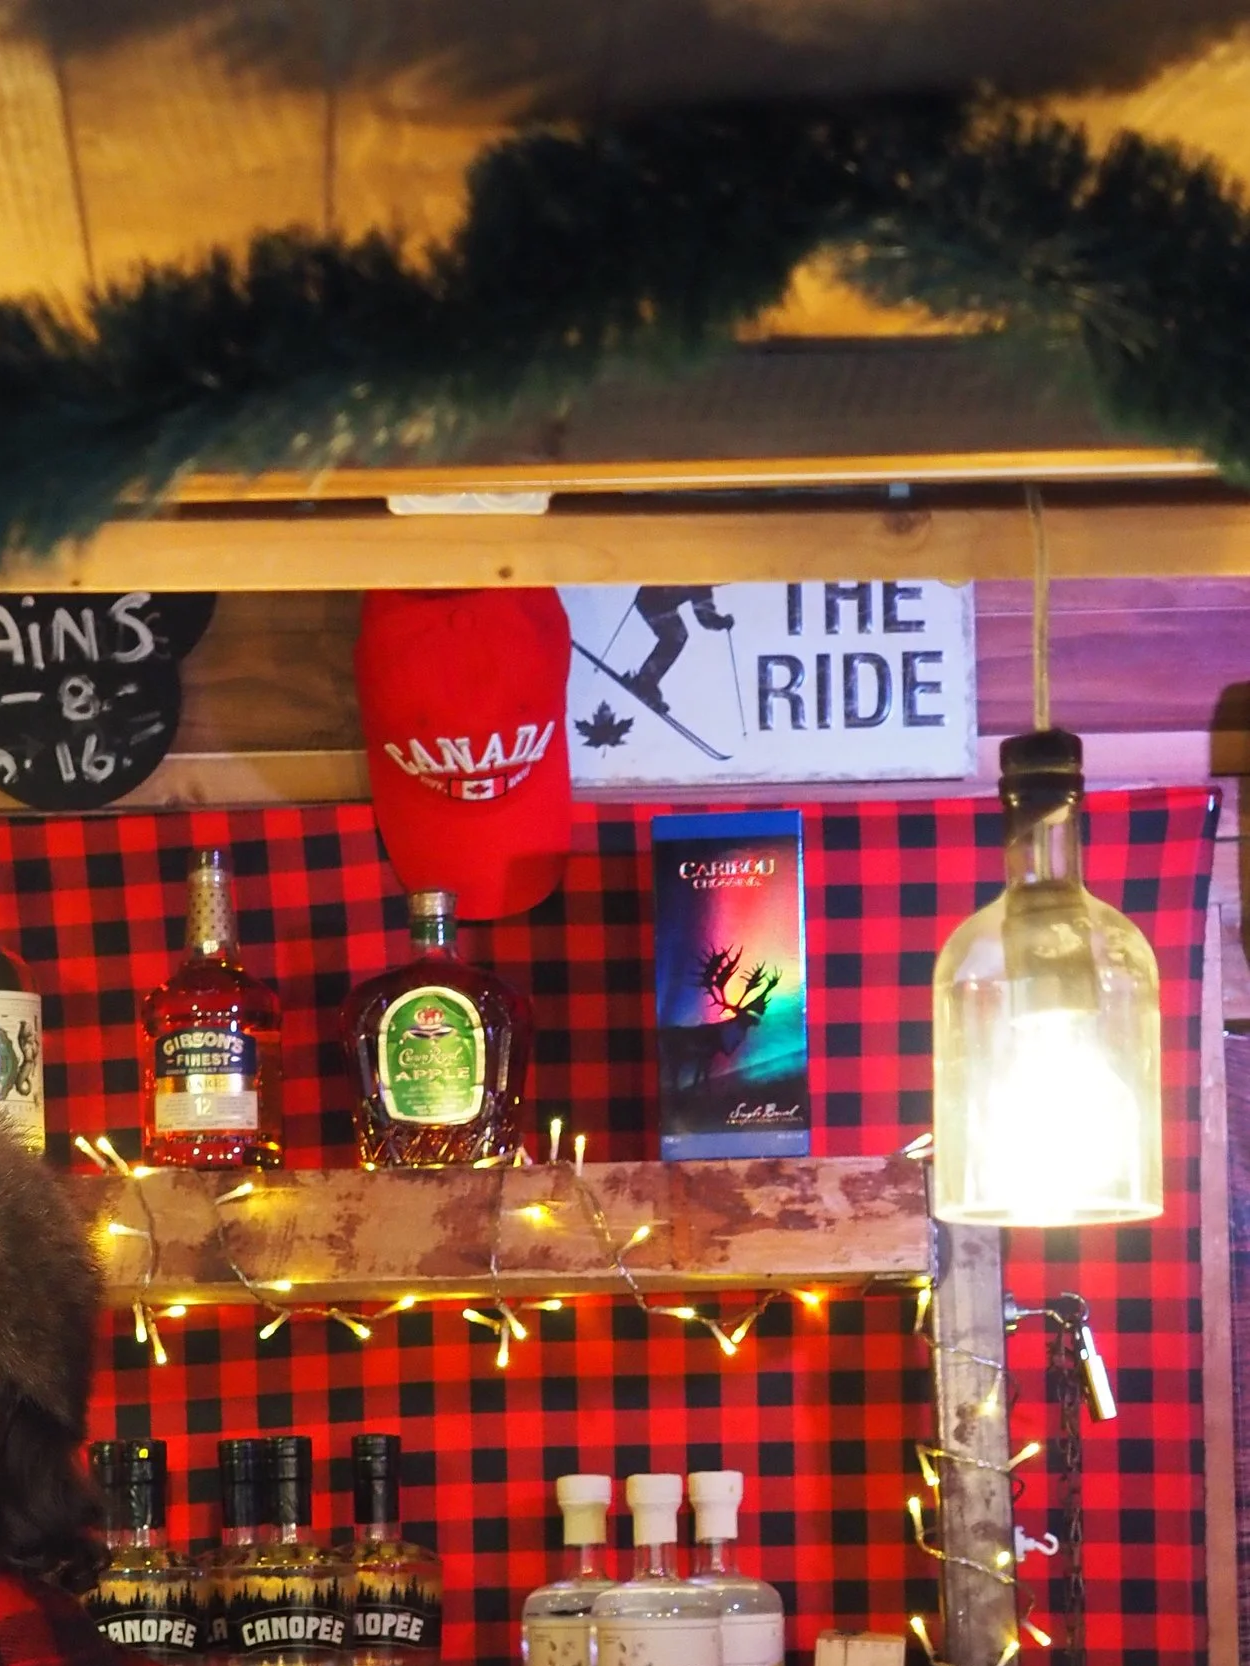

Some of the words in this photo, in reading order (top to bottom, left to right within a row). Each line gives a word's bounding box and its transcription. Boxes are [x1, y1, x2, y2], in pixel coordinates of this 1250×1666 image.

[786, 581, 926, 636] THE
[757, 649, 947, 731] RIDE
[383, 720, 556, 777] CANADA
[679, 858, 776, 880] CARIBOU
[163, 1031, 244, 1056] GIBSON'S
[176, 1053, 232, 1066] FINEST
[394, 1066, 470, 1082] APPLE
[194, 1096, 213, 1116] 12
[241, 1615, 346, 1647] CANOPÉE
